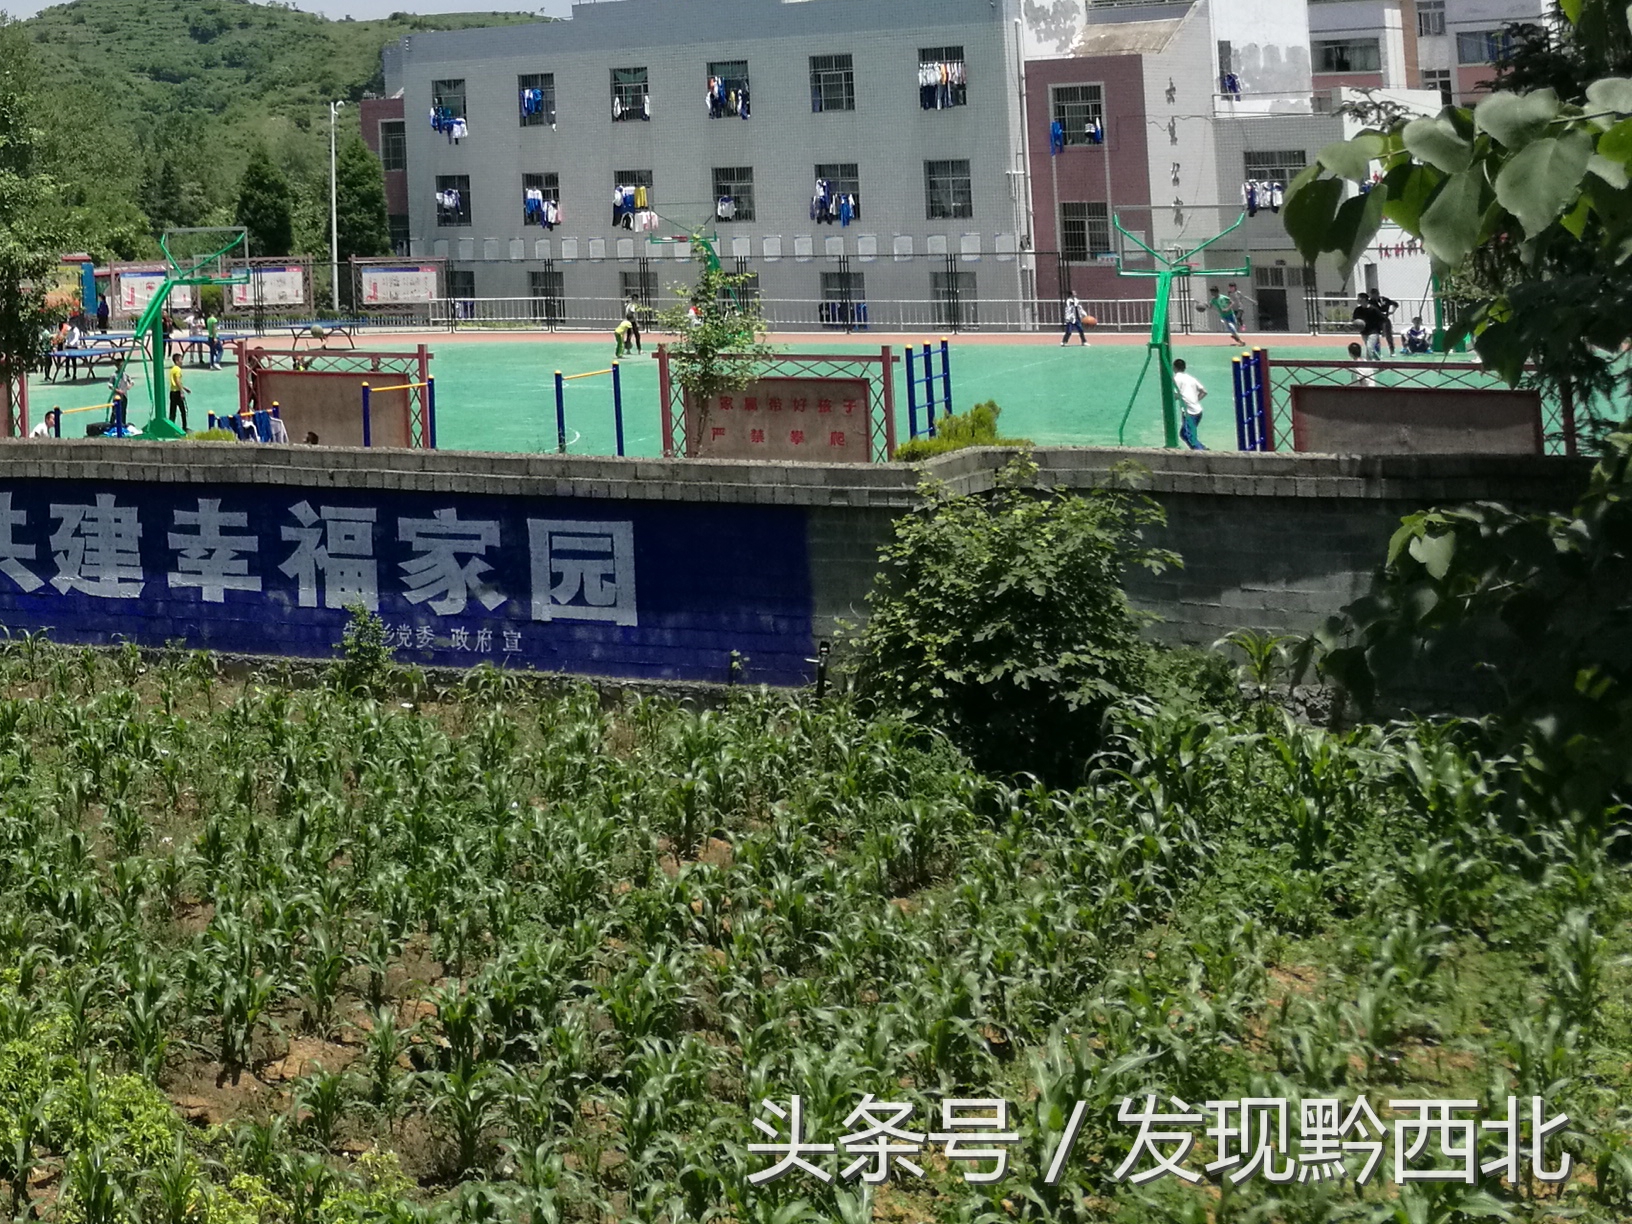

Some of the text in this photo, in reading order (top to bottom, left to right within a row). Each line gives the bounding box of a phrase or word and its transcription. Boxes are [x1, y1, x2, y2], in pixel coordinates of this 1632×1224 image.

[704, 396, 858, 417] 家属带好孩子
[710, 426, 846, 447] 严禁攀爬
